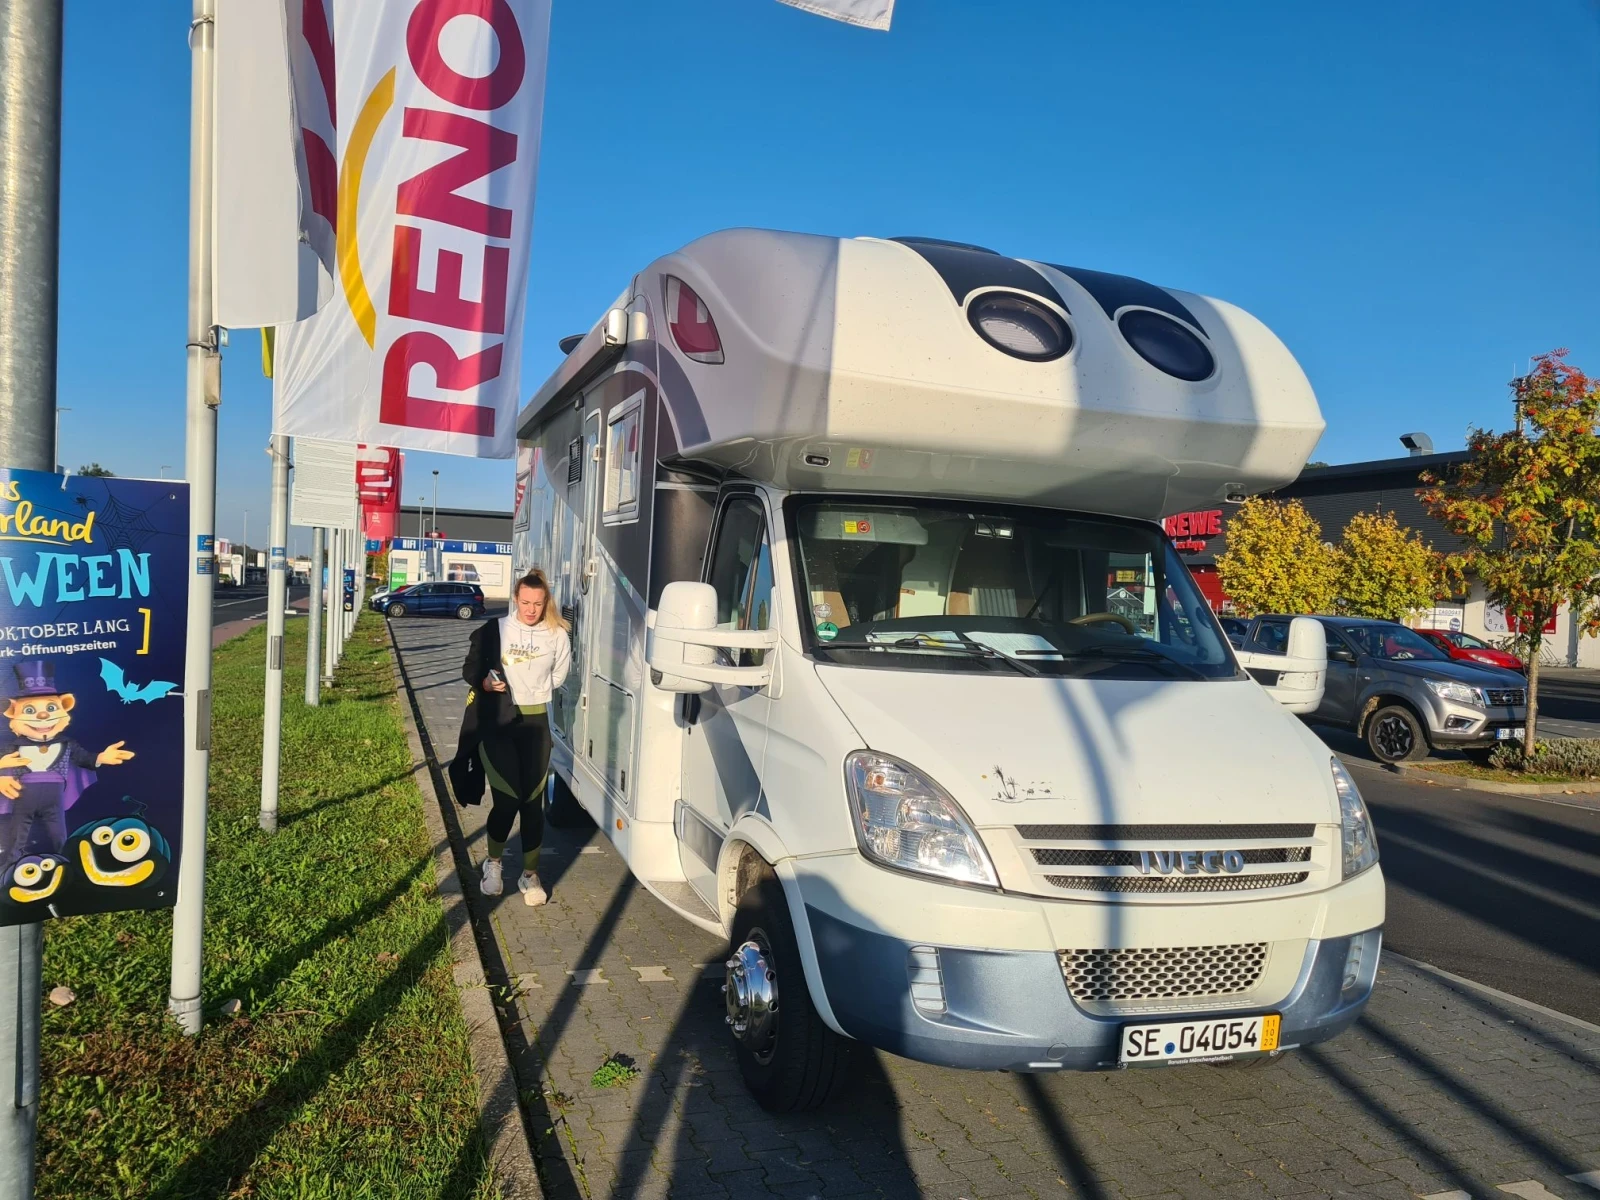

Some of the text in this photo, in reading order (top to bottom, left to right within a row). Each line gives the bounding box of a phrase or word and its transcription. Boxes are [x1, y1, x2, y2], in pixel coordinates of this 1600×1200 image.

[380, 0, 525, 437] RENO
[1163, 510, 1223, 537] REWE
[403, 539, 416, 549] HIFI
[436, 541, 445, 551] TV
[463, 542, 477, 552] DVD
[83, 618, 130, 635] LANG
[1139, 850, 1244, 875] IVECO
[1266, 1019, 1276, 1028] 11
[1126, 1021, 1258, 1057] SE 04054
[1265, 1029, 1275, 1037] 10
[1263, 1038, 1274, 1047] 22
